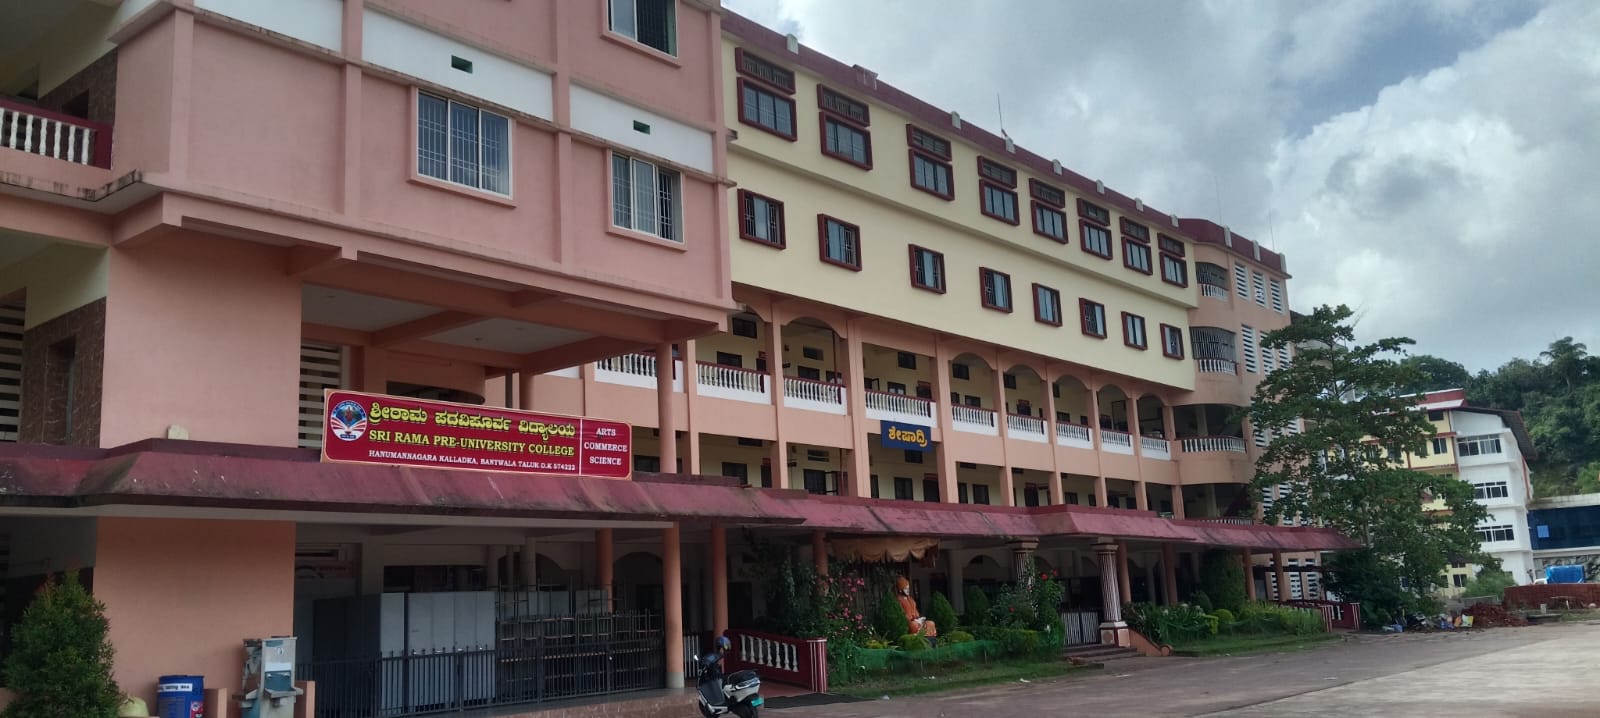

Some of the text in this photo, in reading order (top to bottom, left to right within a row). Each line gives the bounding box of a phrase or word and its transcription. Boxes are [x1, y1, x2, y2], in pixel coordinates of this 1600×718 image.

[368, 401, 428, 424] ಶ್ರೀರಾಮ
[435, 410, 512, 431] ಪದವಿಪೂರ್ವ
[518, 419, 576, 441] ವಿದ್ಯಾಲಯ
[596, 427, 617, 436] ARTS
[888, 425, 928, 448] ಶೇಷಾದ್ರಿ
[369, 430, 575, 457] SRI RAMA PRE-UNIVERSITY COLLEGE
[584, 441, 628, 453] COMMERCE
[368, 449, 437, 462] HANUMANNAGARA
[480, 458, 517, 468] BANTWALA
[518, 461, 540, 469] TALUK
[589, 456, 622, 466] SCIENCE
